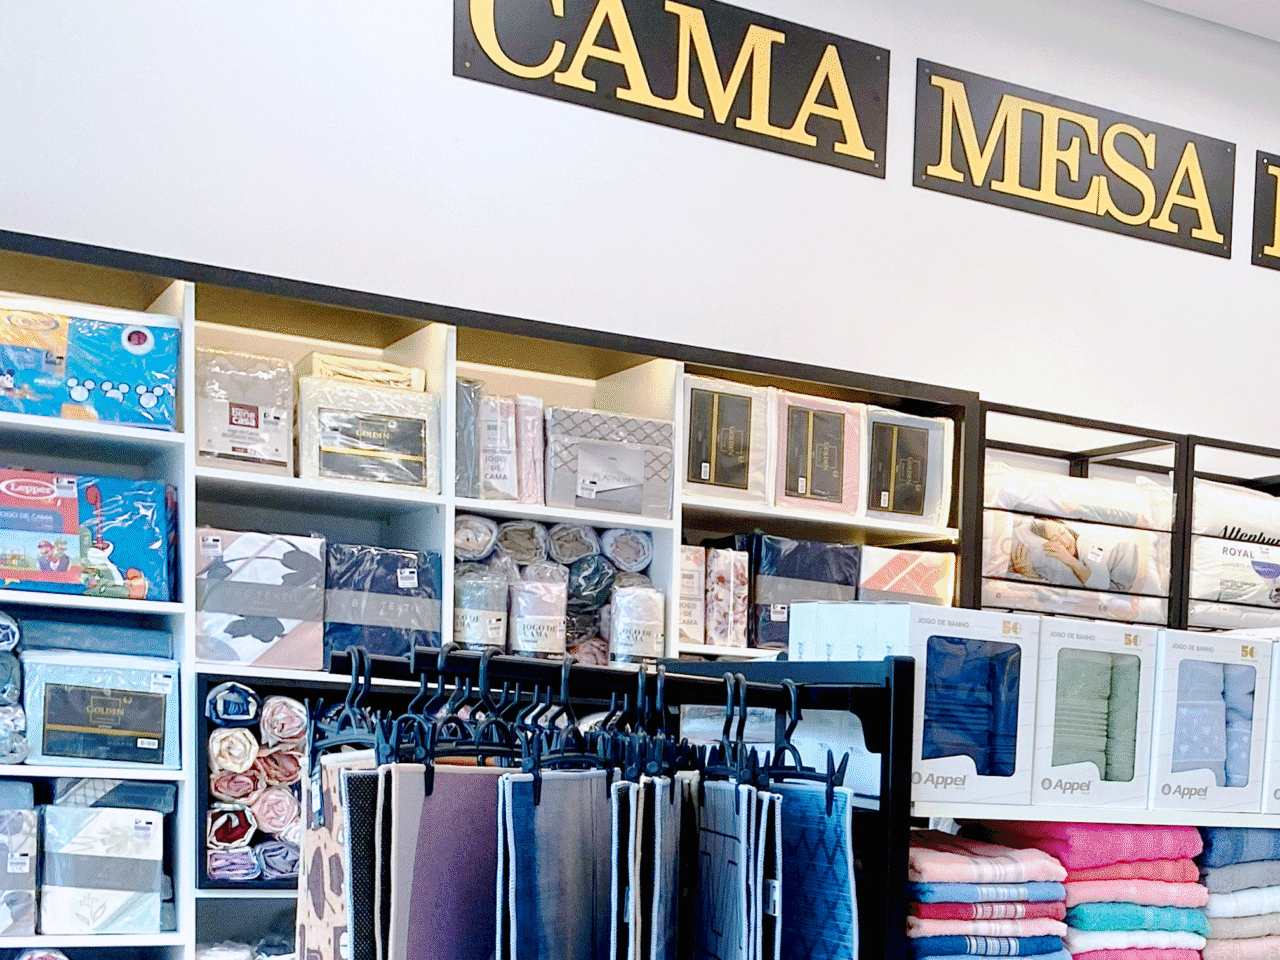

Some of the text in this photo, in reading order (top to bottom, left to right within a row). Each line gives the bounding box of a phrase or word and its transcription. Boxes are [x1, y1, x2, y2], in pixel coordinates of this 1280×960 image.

[469, 0, 875, 161] CAMA
[926, 74, 1224, 244] MESA
[356, 428, 390, 440] GOLDEN
[10, 481, 50, 494] Lepper
[1222, 546, 1256, 559] ROYAL
[522, 623, 545, 632] JOGO
[947, 620, 970, 628] BANHO
[1076, 633, 1096, 641] BANHO
[1196, 645, 1215, 653] BANHO
[86, 705, 125, 716] GOLDEN
[924, 772, 967, 789] Appel
[1052, 778, 1092, 794] Appel
[1172, 784, 1208, 798] Appel
